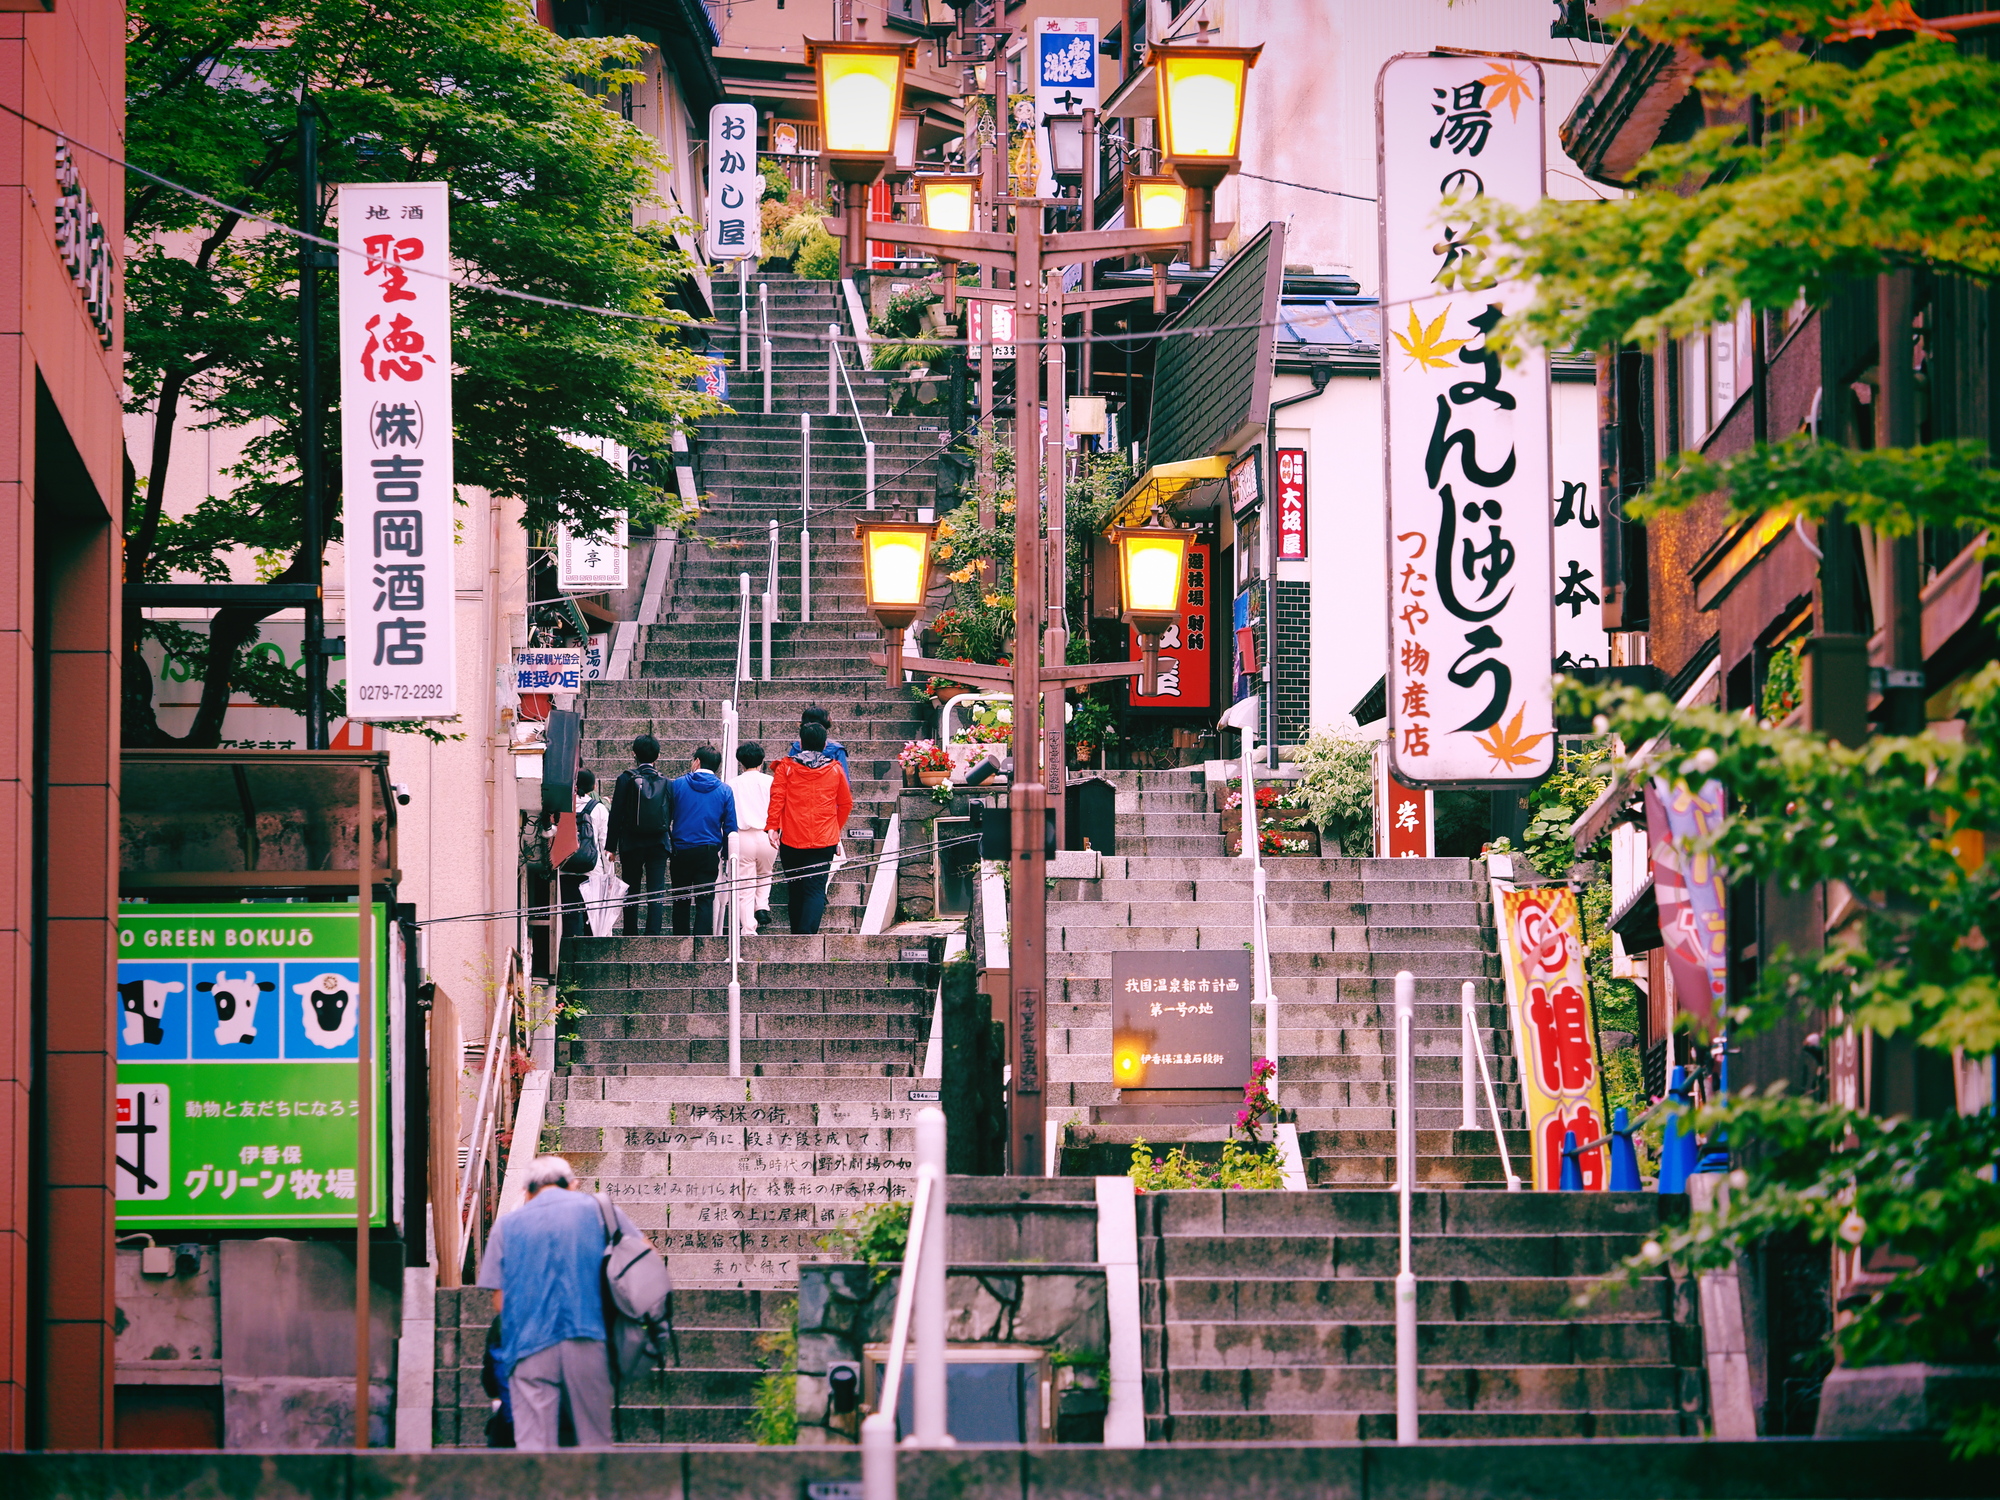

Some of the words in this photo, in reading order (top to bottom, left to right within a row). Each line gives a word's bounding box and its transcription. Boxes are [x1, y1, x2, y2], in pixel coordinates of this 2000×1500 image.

[1046, 20, 1089, 33] 地酒
[718, 115, 746, 246] おかし屋
[365, 205, 424, 220] 地酒
[1396, 531, 1432, 757] つたや物産店
[516, 653, 580, 666] 伊香保観光協会
[517, 670, 580, 688] 推奨の店
[359, 683, 443, 701] 0279-72-2292
[143, 929, 216, 947] GREEN
[225, 928, 314, 947] BOKUJŌ
[1124, 977, 1240, 993] 我国温泉都市計画
[1149, 1001, 1214, 1018] 第一号の地
[1140, 1052, 1225, 1065] 伊香保温泉石段街
[185, 1100, 359, 1118] 動物と友だちになろう
[685, 1104, 792, 1126] 「伊香保の街」
[239, 1145, 303, 1165] 伊香保
[184, 1163, 358, 1200] グリーン牧場
